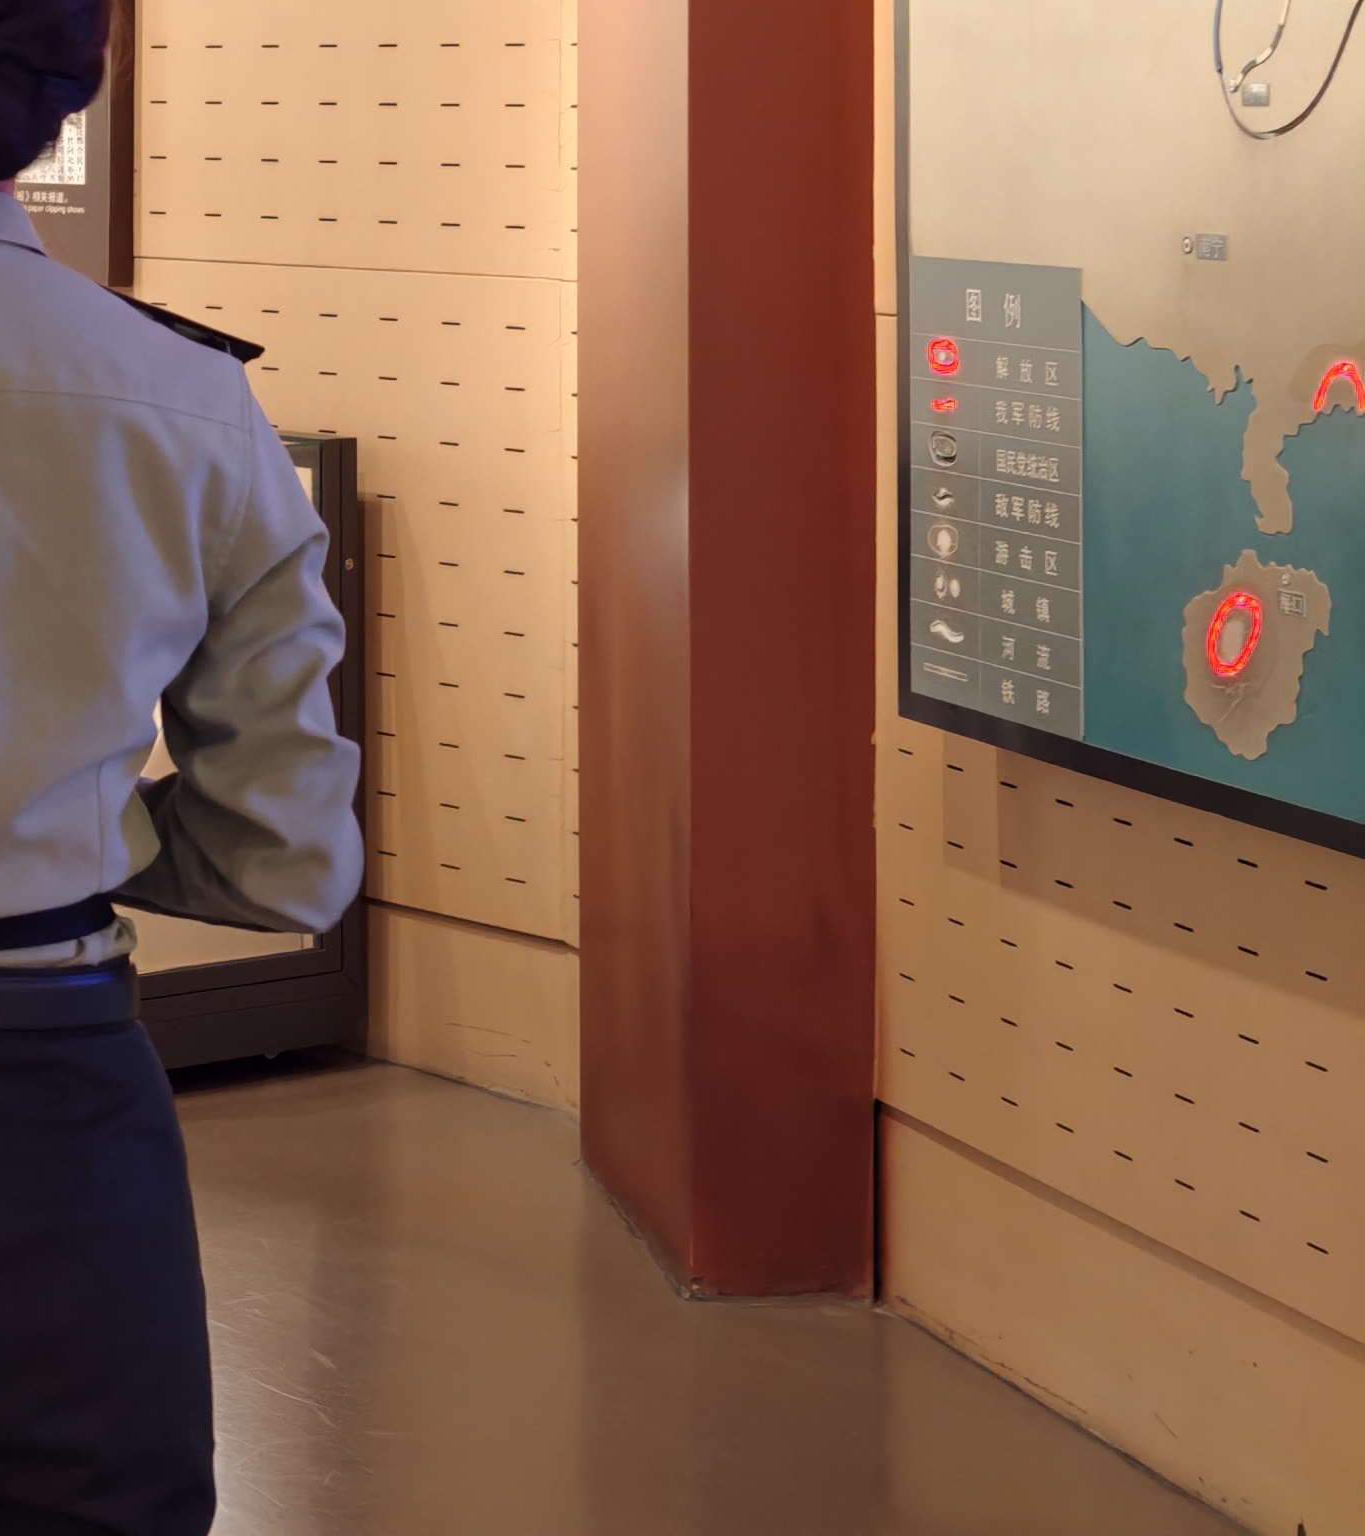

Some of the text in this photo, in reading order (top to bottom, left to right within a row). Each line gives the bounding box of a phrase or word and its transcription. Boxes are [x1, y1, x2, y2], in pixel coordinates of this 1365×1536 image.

[965, 288, 1023, 329] 图例
[995, 356, 1060, 386] 解放区
[995, 400, 1061, 432] 我军防线
[995, 448, 1060, 483] 国民党统治区
[994, 493, 1060, 528] 敌军防线
[994, 540, 1059, 576] 游击区
[1001, 636, 1052, 670] 河流
[1000, 679, 1051, 716] 铁路
